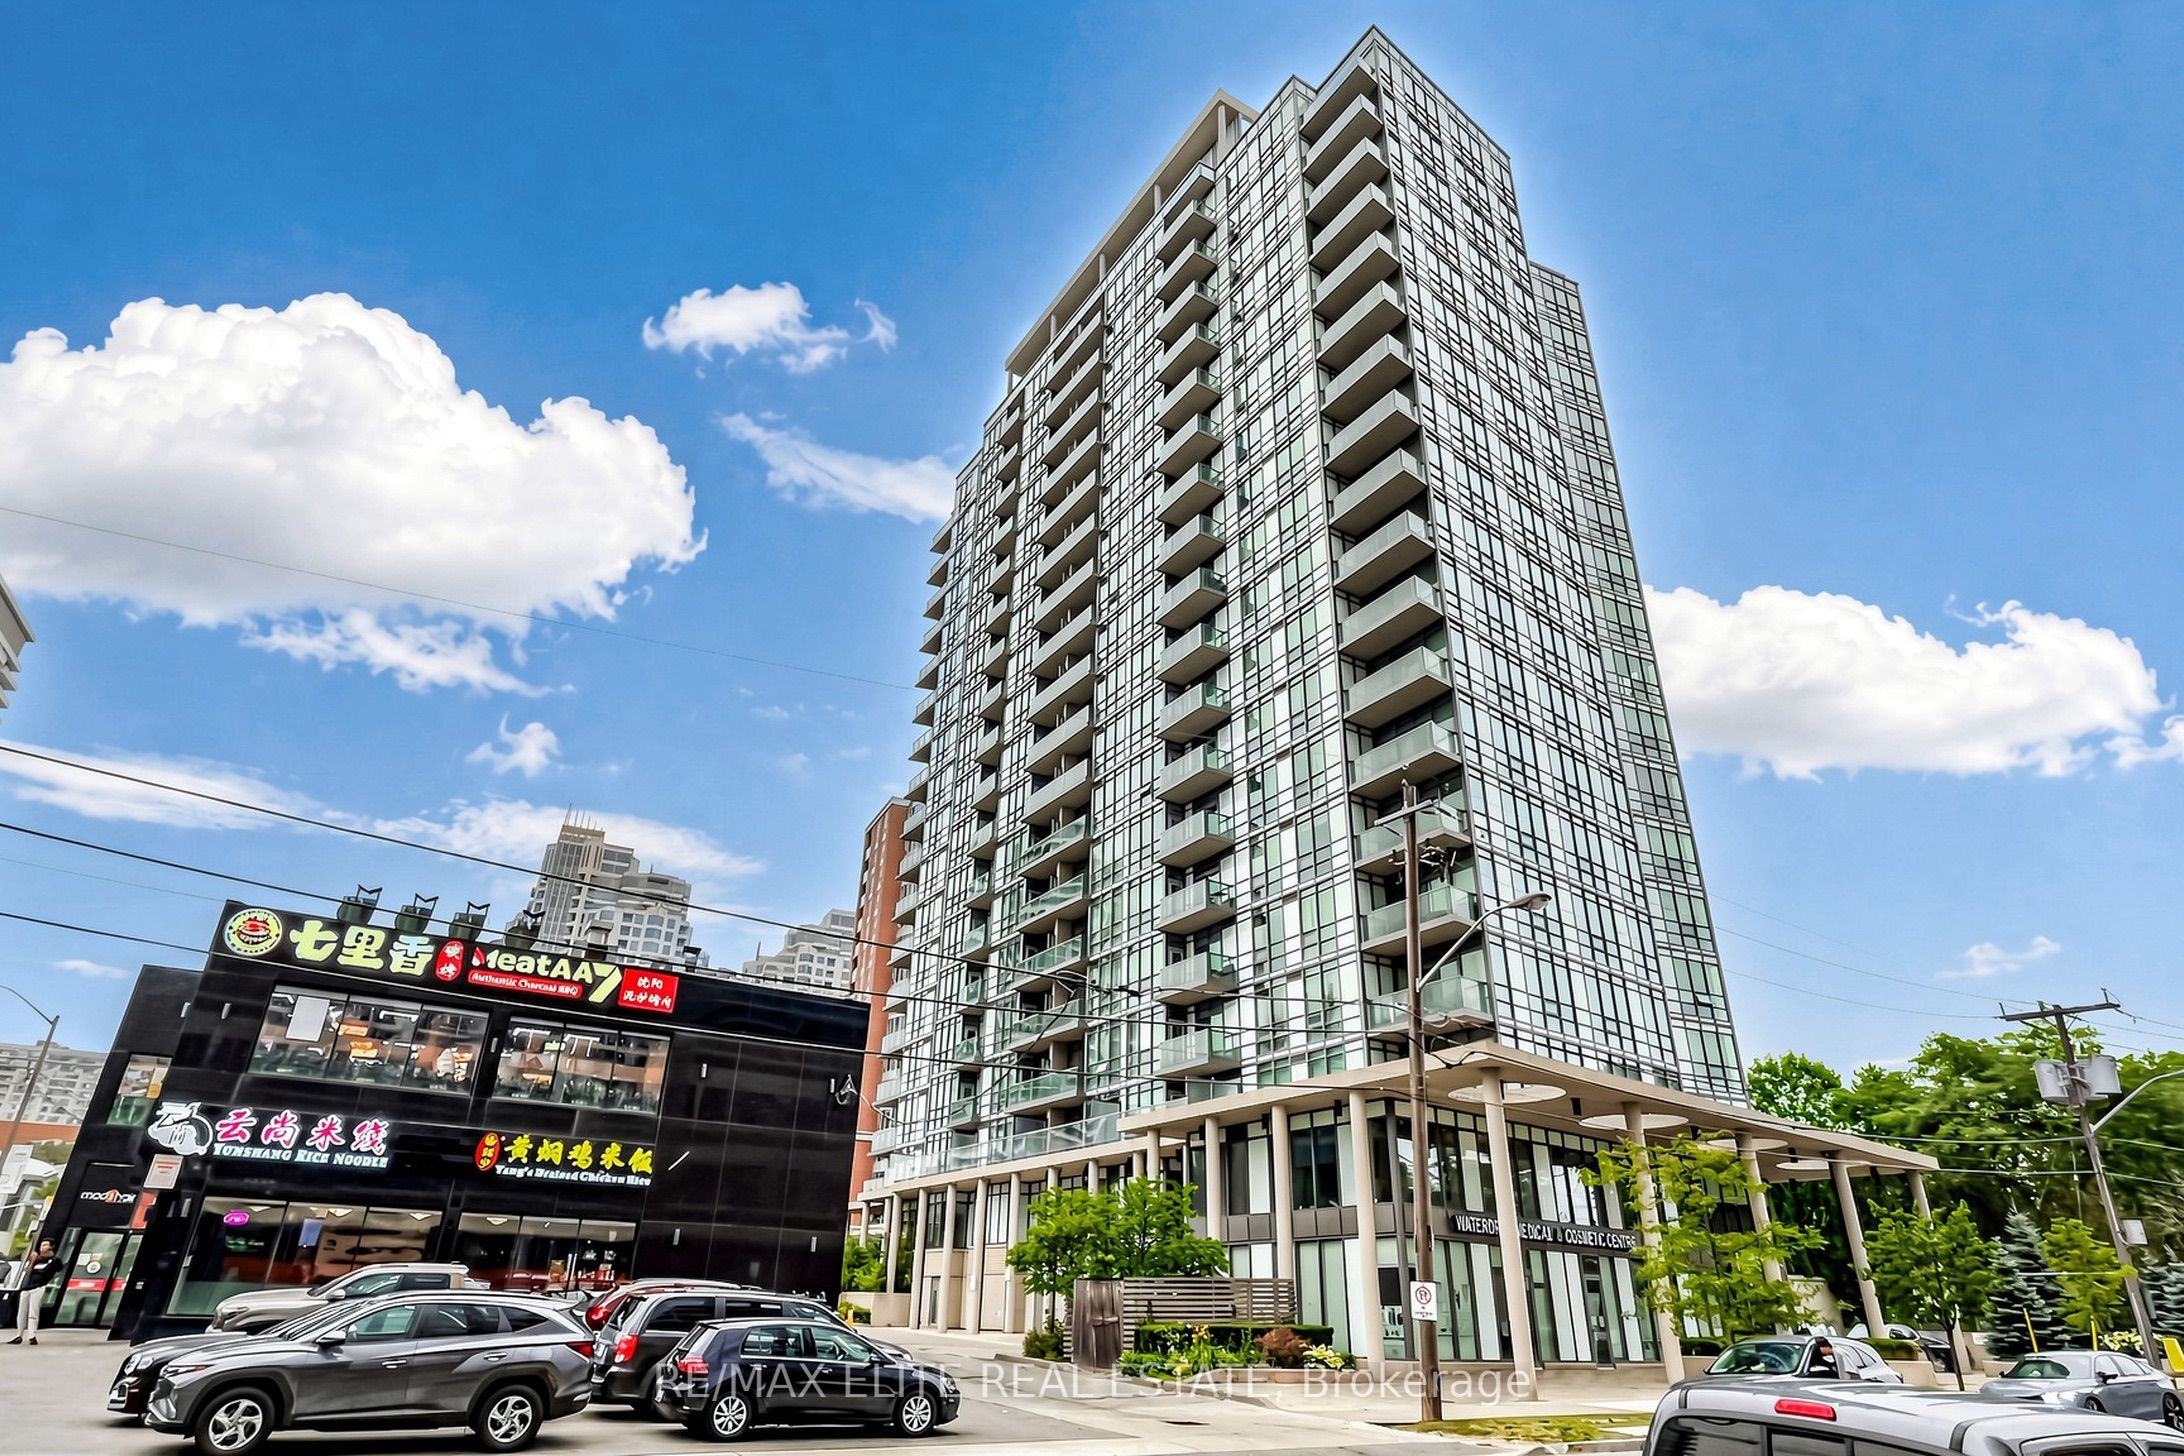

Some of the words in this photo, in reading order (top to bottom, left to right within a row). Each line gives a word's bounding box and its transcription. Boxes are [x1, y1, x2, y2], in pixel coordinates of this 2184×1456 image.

[289, 919, 435, 976] 七里香
[332, 1152, 389, 1169] NOODLE
[1564, 1228, 1606, 1248] COSMETIC
